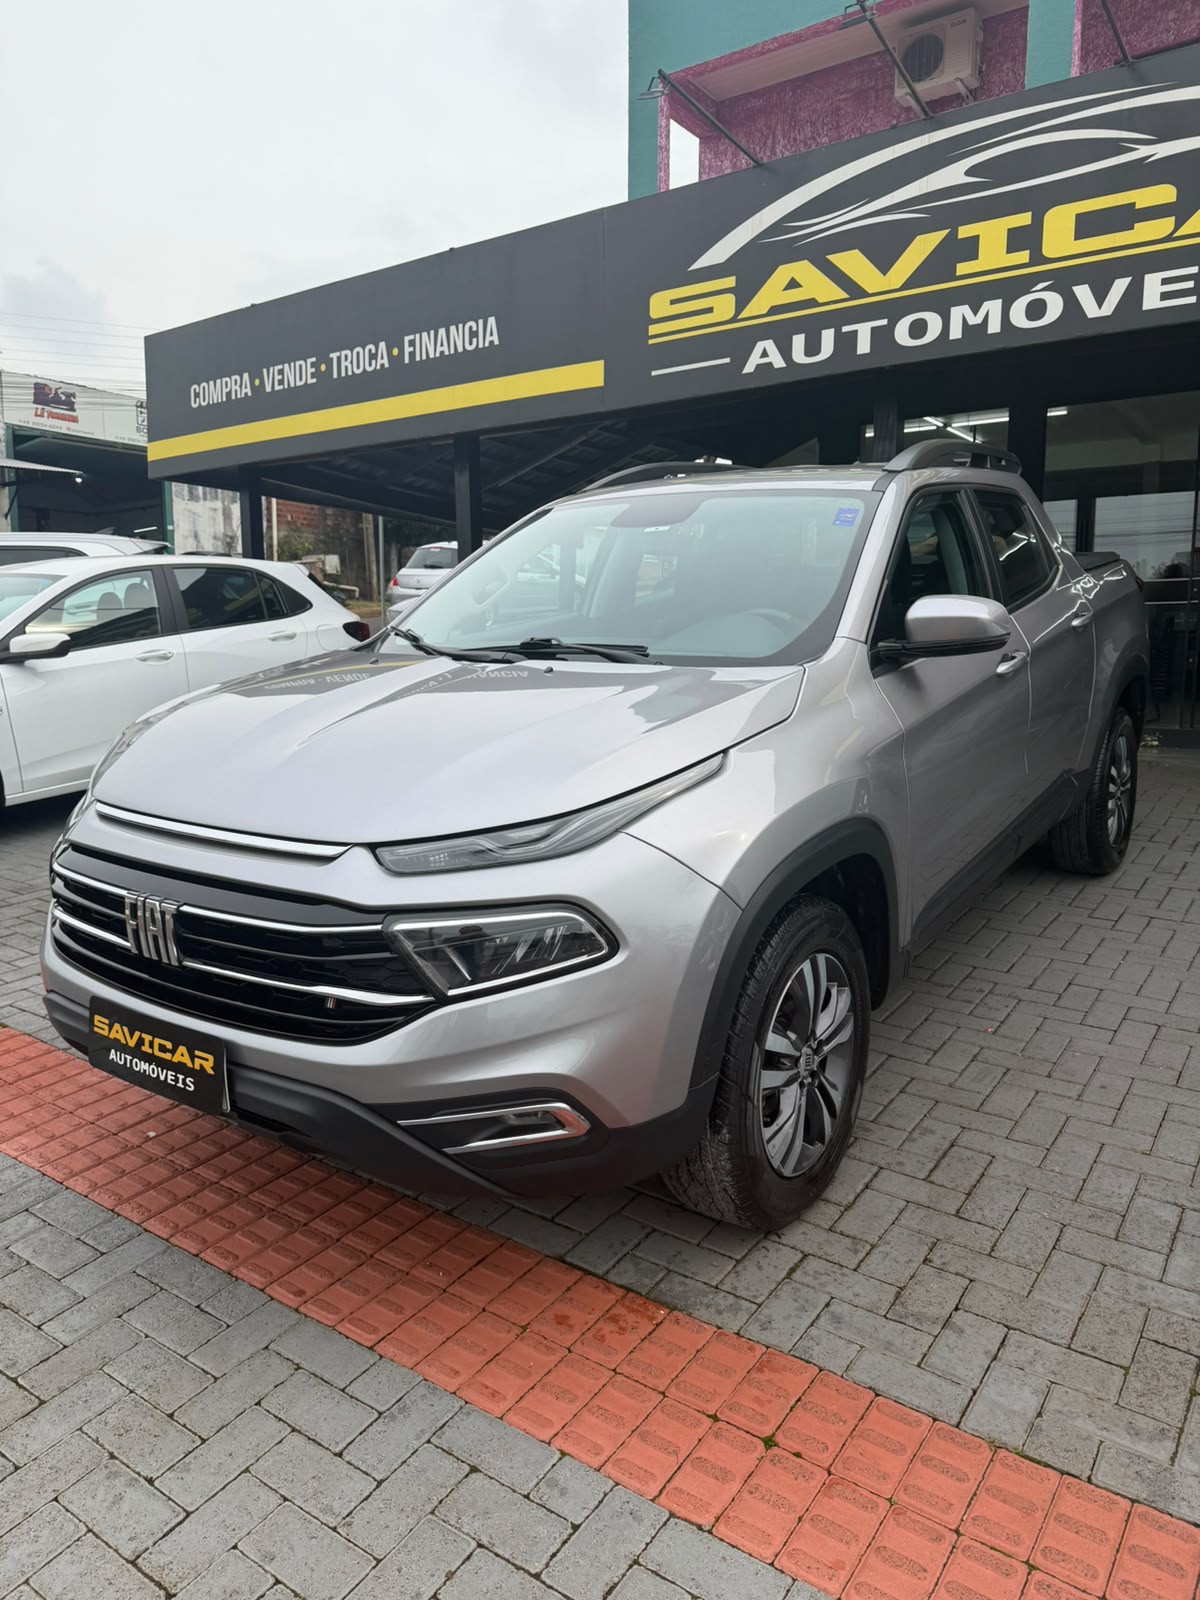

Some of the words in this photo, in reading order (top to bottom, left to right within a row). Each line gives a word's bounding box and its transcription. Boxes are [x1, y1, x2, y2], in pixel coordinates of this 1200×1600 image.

[648, 183, 1200, 337] SAVIC
[742, 266, 1199, 374] AUTOMÓVE
[190, 372, 252, 408] COMPRA
[262, 356, 317, 393] VENDE
[329, 341, 389, 379] TROCA
[403, 316, 499, 364] FINANCIA
[124, 893, 179, 966] FIAT
[93, 1014, 215, 1075] SAVICAR
[108, 1048, 195, 1092] AUTOMÓVEIS
